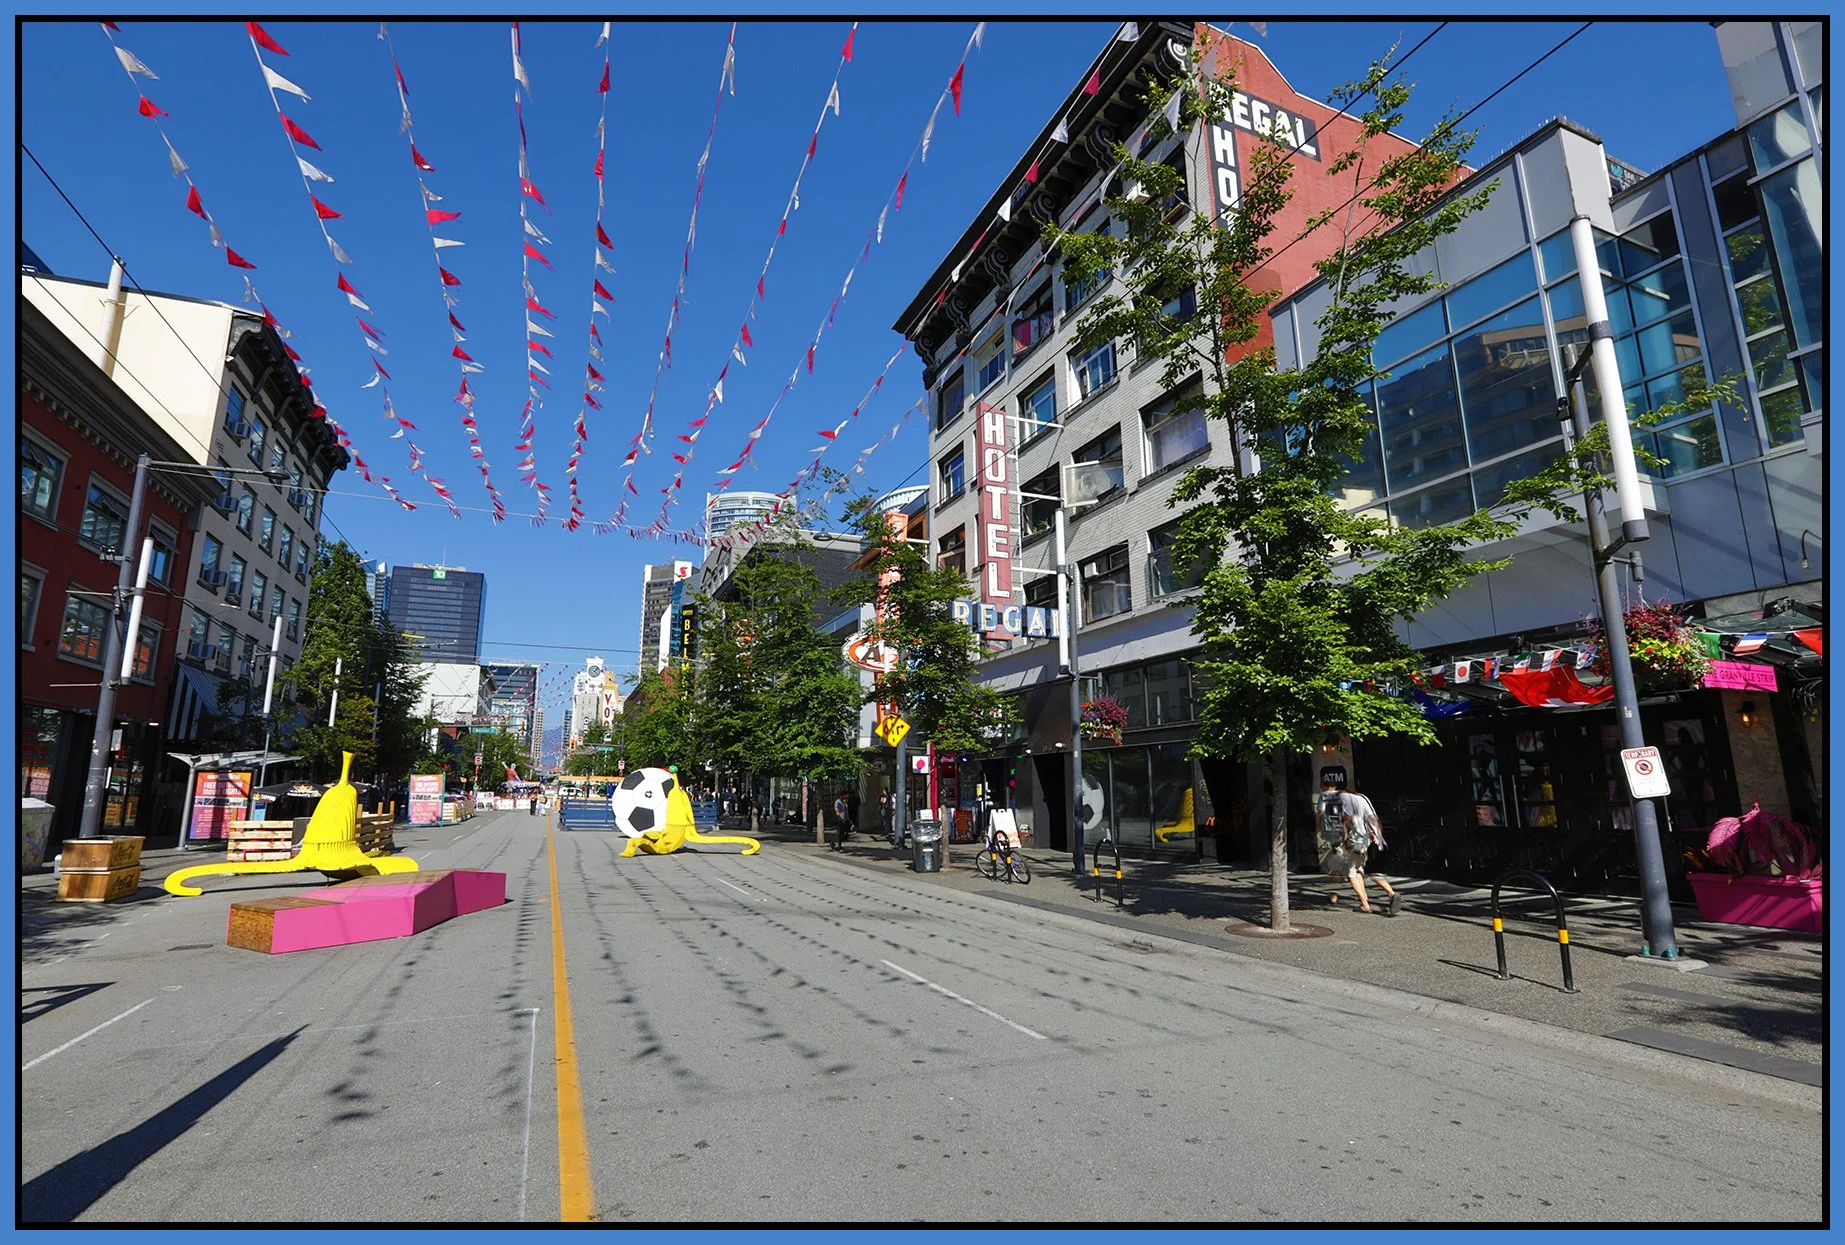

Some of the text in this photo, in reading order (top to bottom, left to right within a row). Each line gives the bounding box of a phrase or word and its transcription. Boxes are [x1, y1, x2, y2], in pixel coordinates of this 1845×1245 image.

[983, 411, 1010, 598] HOTEL
[1757, 673, 1774, 683] STRIP
[1324, 773, 1344, 782] ATM
